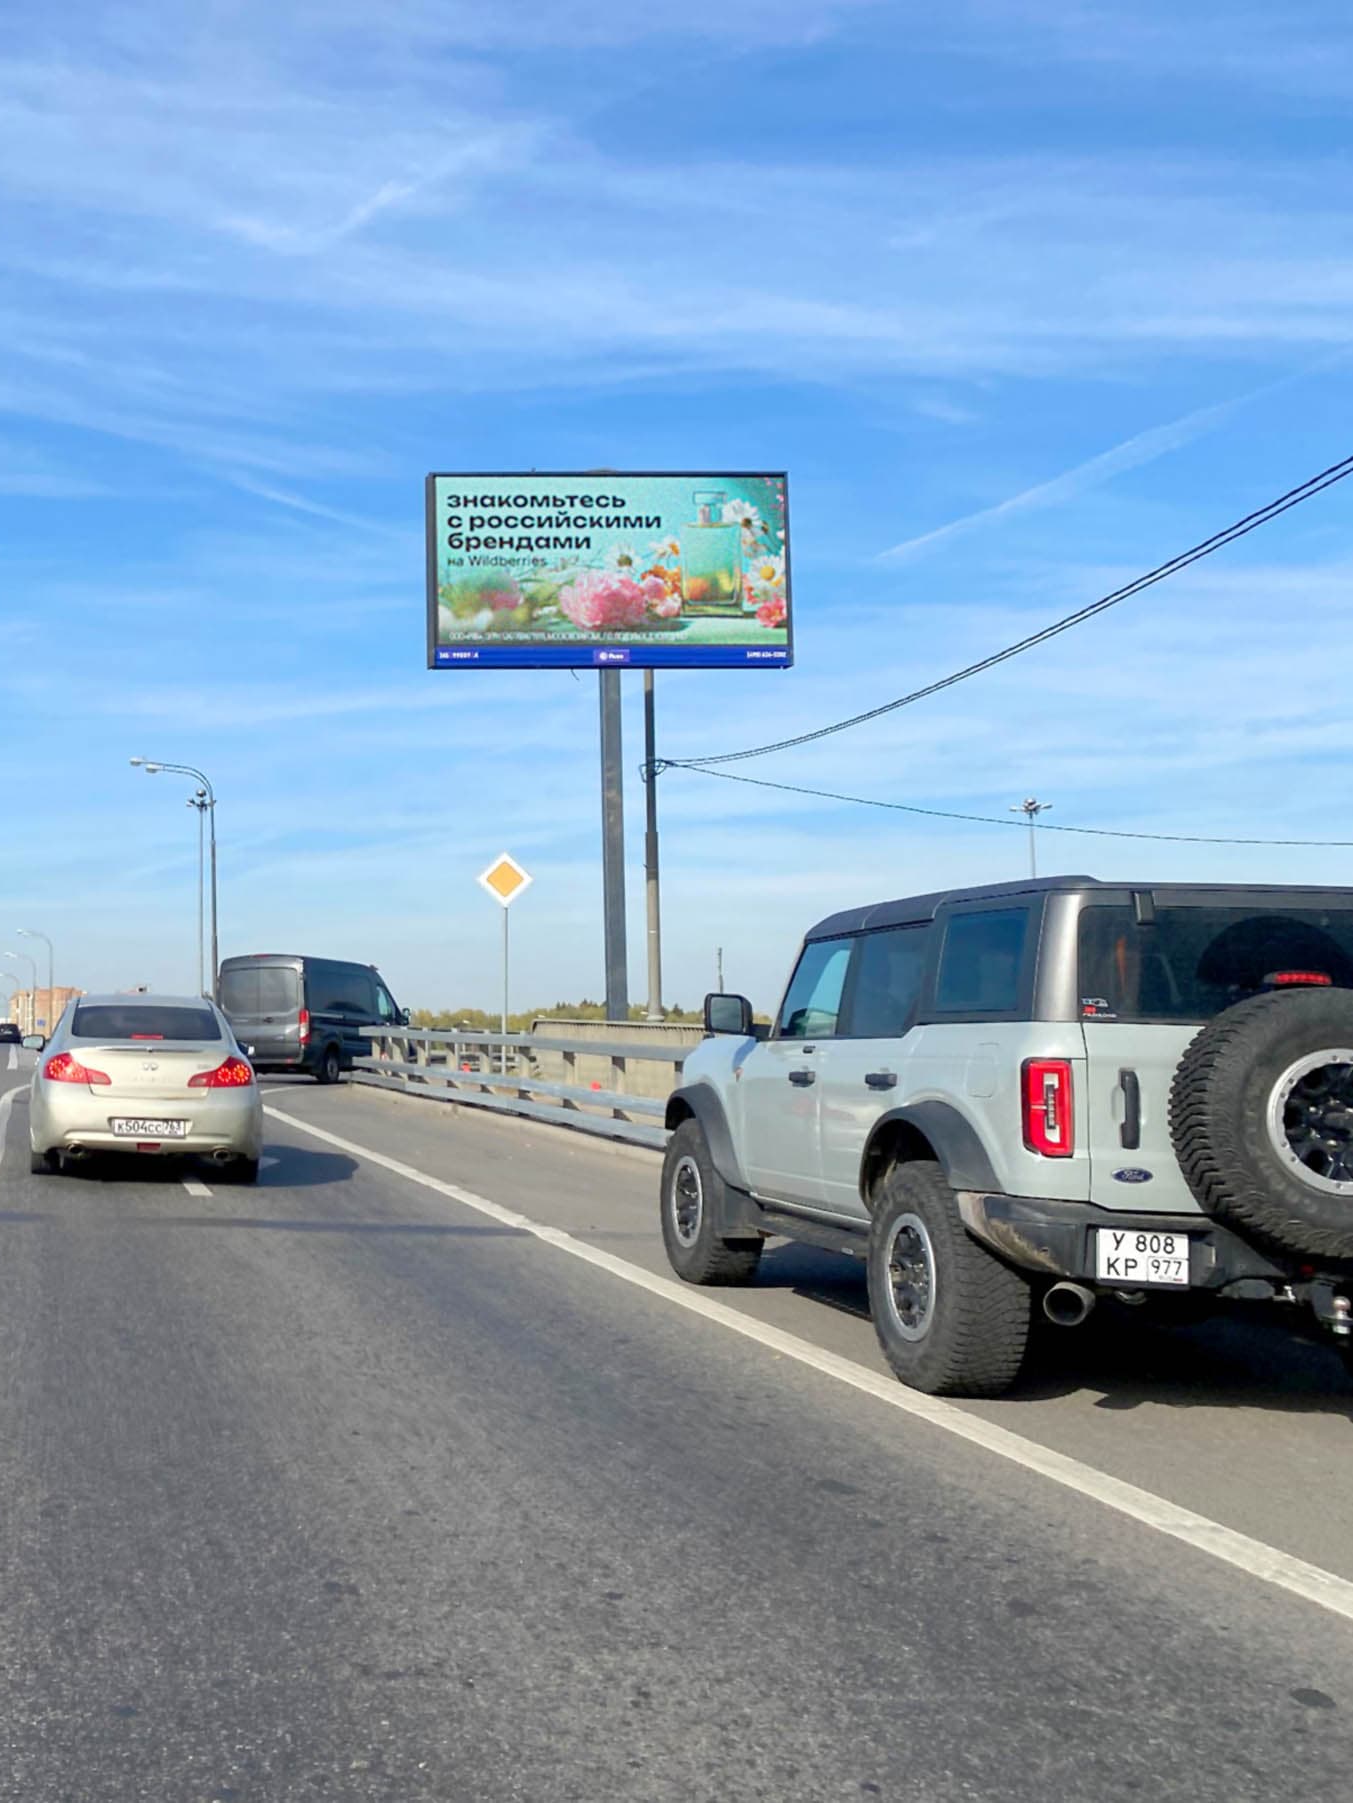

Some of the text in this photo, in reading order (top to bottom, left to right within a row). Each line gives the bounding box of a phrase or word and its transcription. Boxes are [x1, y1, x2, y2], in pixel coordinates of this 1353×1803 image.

[447, 494, 626, 509] знакомьтесь
[447, 510, 662, 532] с российскими
[448, 532, 591, 552] брендами
[447, 555, 548, 568] на Wildberries
[1135, 1234, 1175, 1254] 808
[1106, 1256, 1182, 1277] КР 977
